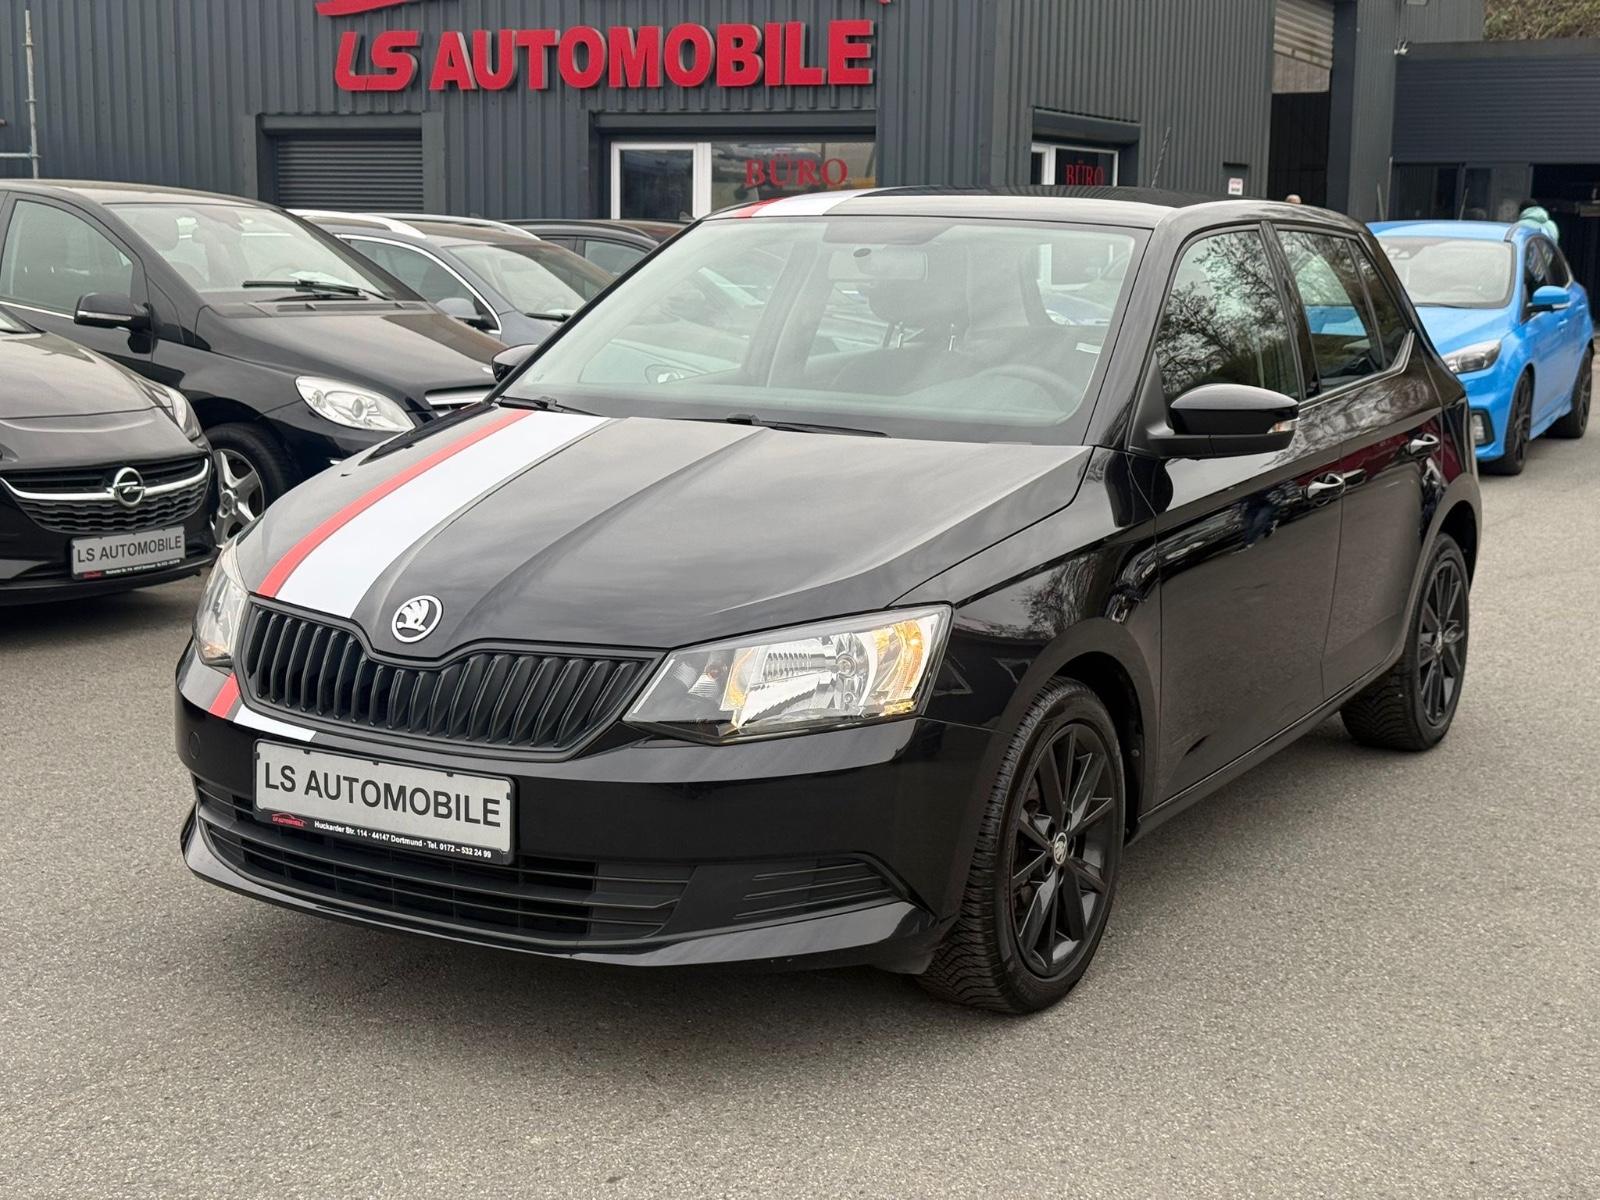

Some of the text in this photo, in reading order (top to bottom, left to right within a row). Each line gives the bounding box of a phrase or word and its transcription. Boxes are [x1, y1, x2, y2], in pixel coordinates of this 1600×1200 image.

[334, 20, 875, 92] LS AUTOMOBILE
[744, 153, 849, 188] BÜRO
[1065, 160, 1105, 186] BÜRO
[77, 535, 182, 563] LS AUTOMOBILE
[264, 762, 501, 828] LS AUTOMOBILE
[314, 820, 345, 833] Huckarder
[357, 829, 368, 837] 114
[371, 831, 390, 841] 44147
[391, 835, 423, 847] Dortmund
[427, 840, 438, 849] Tel.
[439, 843, 455, 852] 0172
[461, 846, 473, 855] 532
[473, 848, 482, 857] 24
[483, 850, 492, 859] 99
